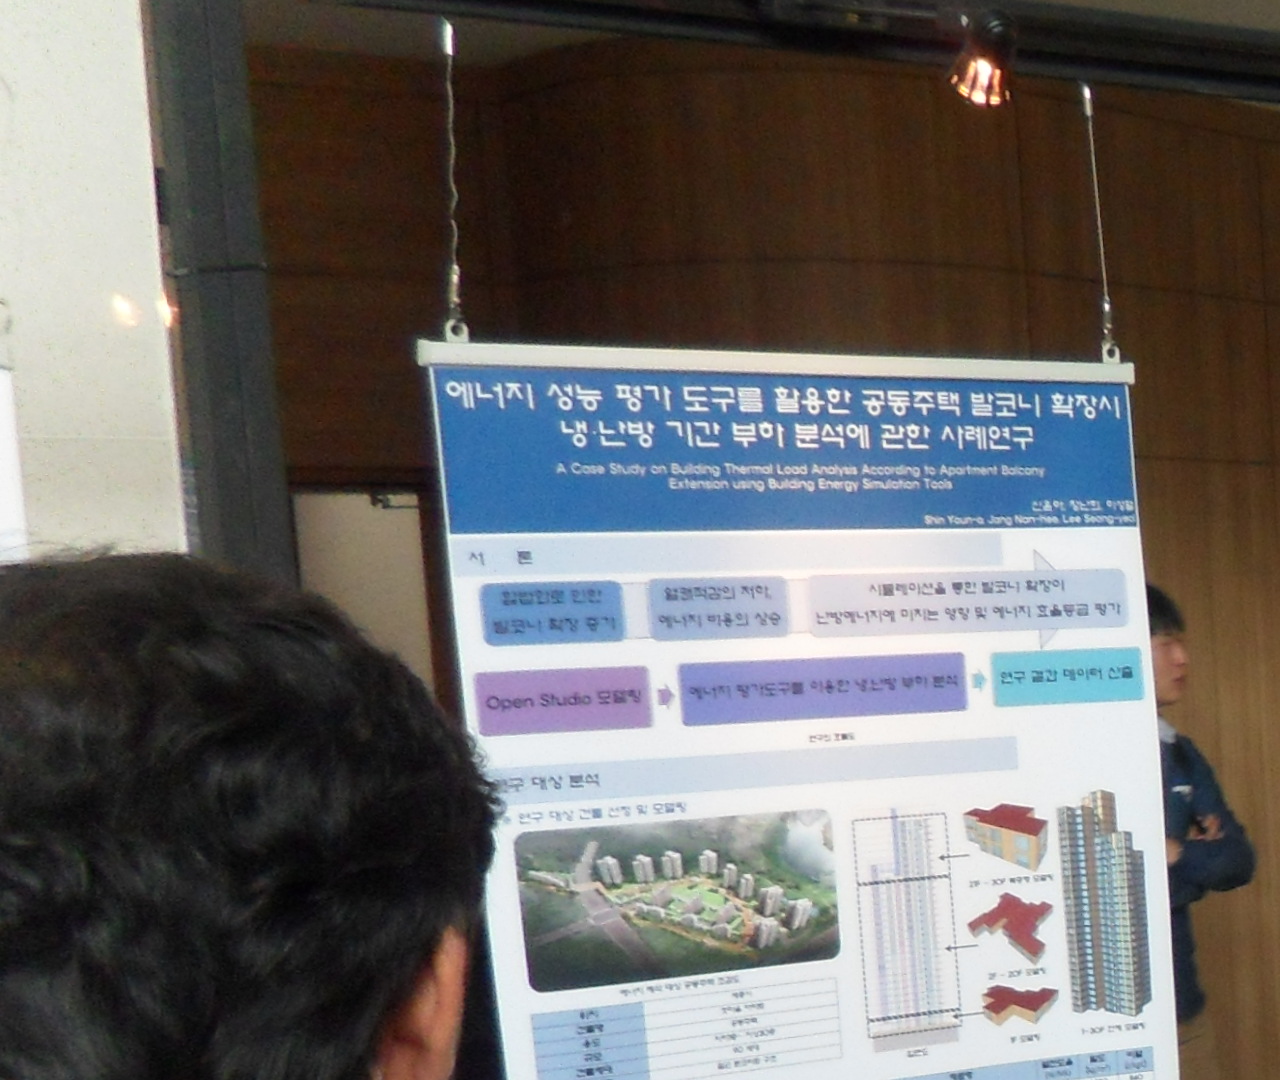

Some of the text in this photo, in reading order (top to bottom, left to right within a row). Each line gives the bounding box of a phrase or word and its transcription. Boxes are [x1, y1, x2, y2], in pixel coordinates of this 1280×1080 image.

[445, 381, 1121, 419] 에너지 성능 평가 도구를 활용한 공동주택 발코니 확장시
[665, 420, 722, 447] 기간
[731, 422, 786, 448] 부하
[794, 422, 870, 450] 분석에
[880, 423, 930, 450] 관한
[941, 425, 1034, 451] 사례연구
[556, 463, 1046, 479] A Case Study on Building Thermal Load Analysis According to Apartment Balcony
[668, 478, 953, 492] Extension using Building Energy Simulation Tools
[981, 579, 1021, 595] 발코니
[900, 607, 940, 623] 미치는
[974, 605, 988, 620] 및
[992, 604, 1032, 619] 에너지
[1094, 600, 1121, 616] 평가
[658, 614, 703, 629] 에너지
[1000, 669, 1026, 686] 연구
[1062, 666, 1103, 682] 데이터
[486, 694, 535, 713] Open
[540, 690, 592, 708] Studio
[688, 684, 732, 701] 에너지
